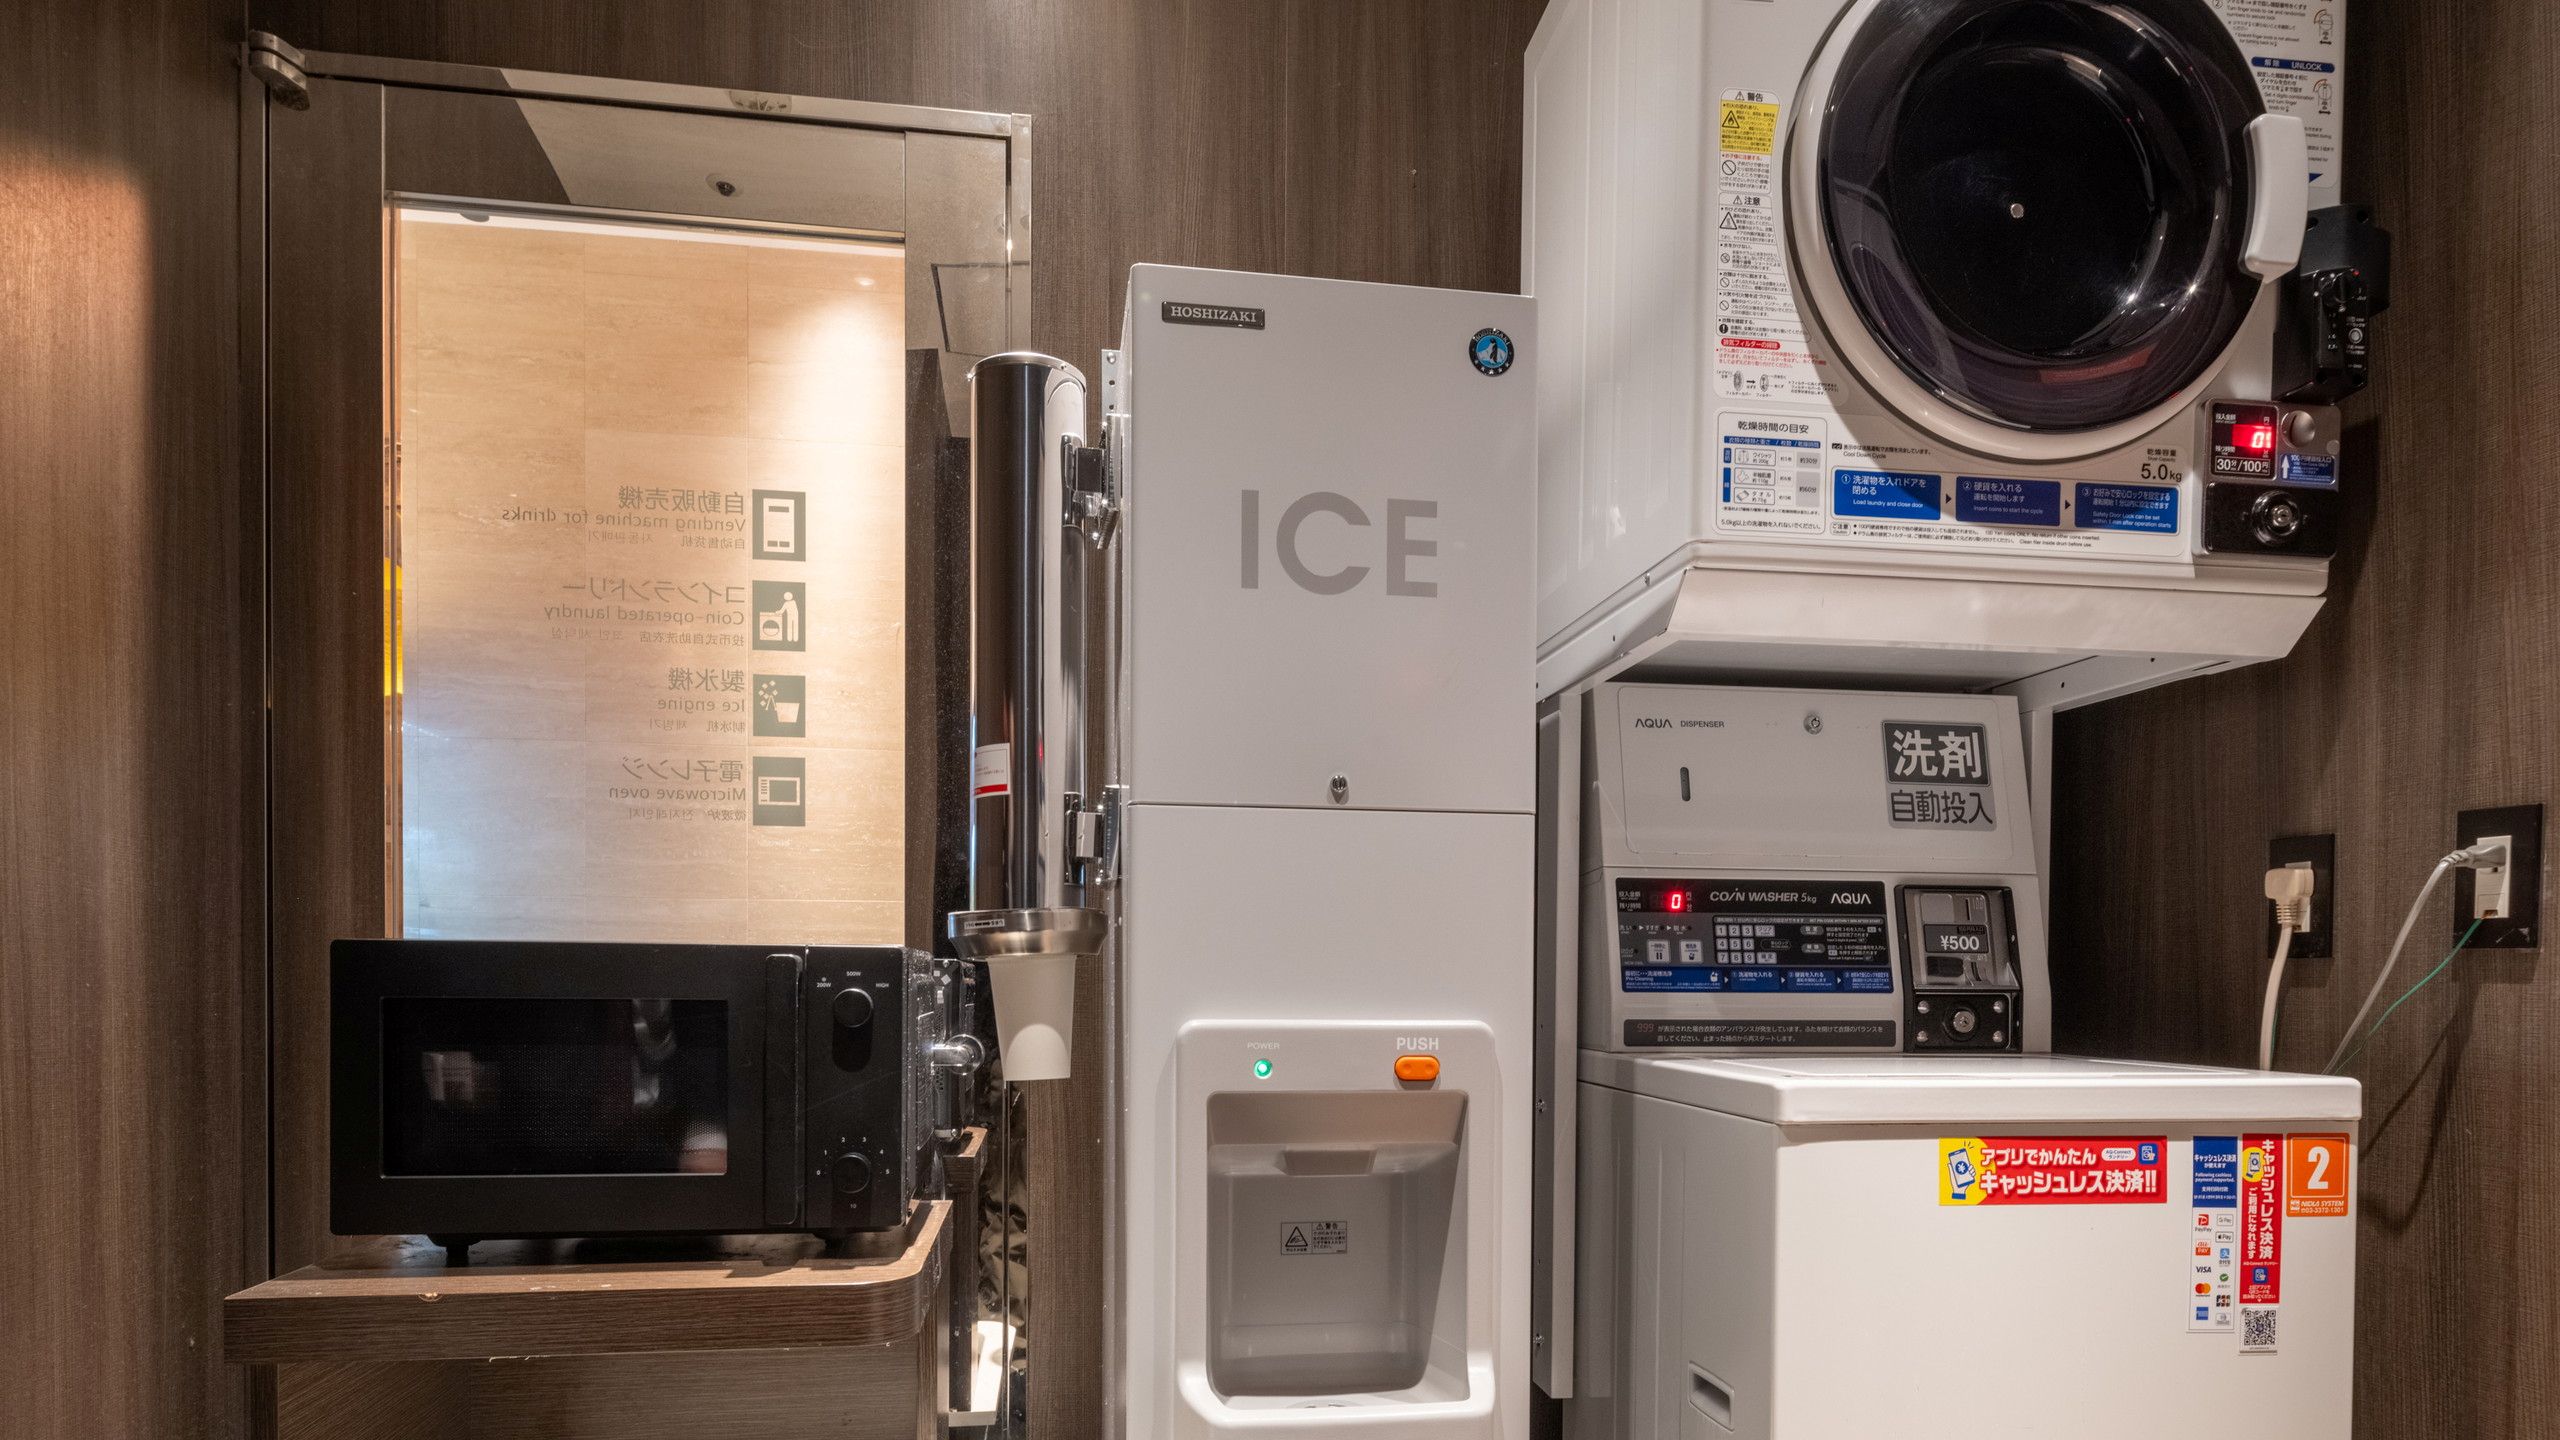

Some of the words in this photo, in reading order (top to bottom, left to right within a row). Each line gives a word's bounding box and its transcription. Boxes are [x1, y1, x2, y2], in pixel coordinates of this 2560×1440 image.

[2292, 61, 2322, 71] UNLOCK
[1748, 92, 1763, 102] 警告
[1744, 196, 1760, 206] 注意
[1171, 306, 1256, 323] HOSHIZAKI
[1738, 420, 1809, 434] 乾燥時間の目安
[2141, 463, 2183, 484] 5.0kg
[1853, 475, 1926, 488] 洗濯物を入れドアを
[1974, 482, 2023, 493] 硬貨を入れる
[1974, 493, 2025, 503] 運転を開始します
[2134, 520, 2157, 528] operation
[1241, 490, 1438, 598] ICE
[1635, 718, 1673, 729] AQUA
[1680, 720, 1725, 728] DISPENSER
[1892, 728, 1983, 779] 洗剤
[1890, 789, 1993, 826] 自動投入
[1671, 894, 1681, 909] 0
[1754, 892, 1799, 903] WASHER
[1801, 892, 1817, 905] 5kg
[1830, 893, 1872, 905] AQUA
[1940, 935, 1980, 951] ¥500
[1247, 1042, 1280, 1050] POWER
[1397, 1037, 1439, 1051] PUSH
[1980, 1148, 2097, 1166] アプリでかんたん
[2194, 1154, 2237, 1163] キャッシュレス決済
[2307, 1146, 2330, 1190] 2
[1980, 1170, 2157, 1194] キャッシュレス決済!!
[2260, 1139, 2276, 1260] キャッシュレス決済
[2247, 1187, 2258, 1260] ご利用になれます
